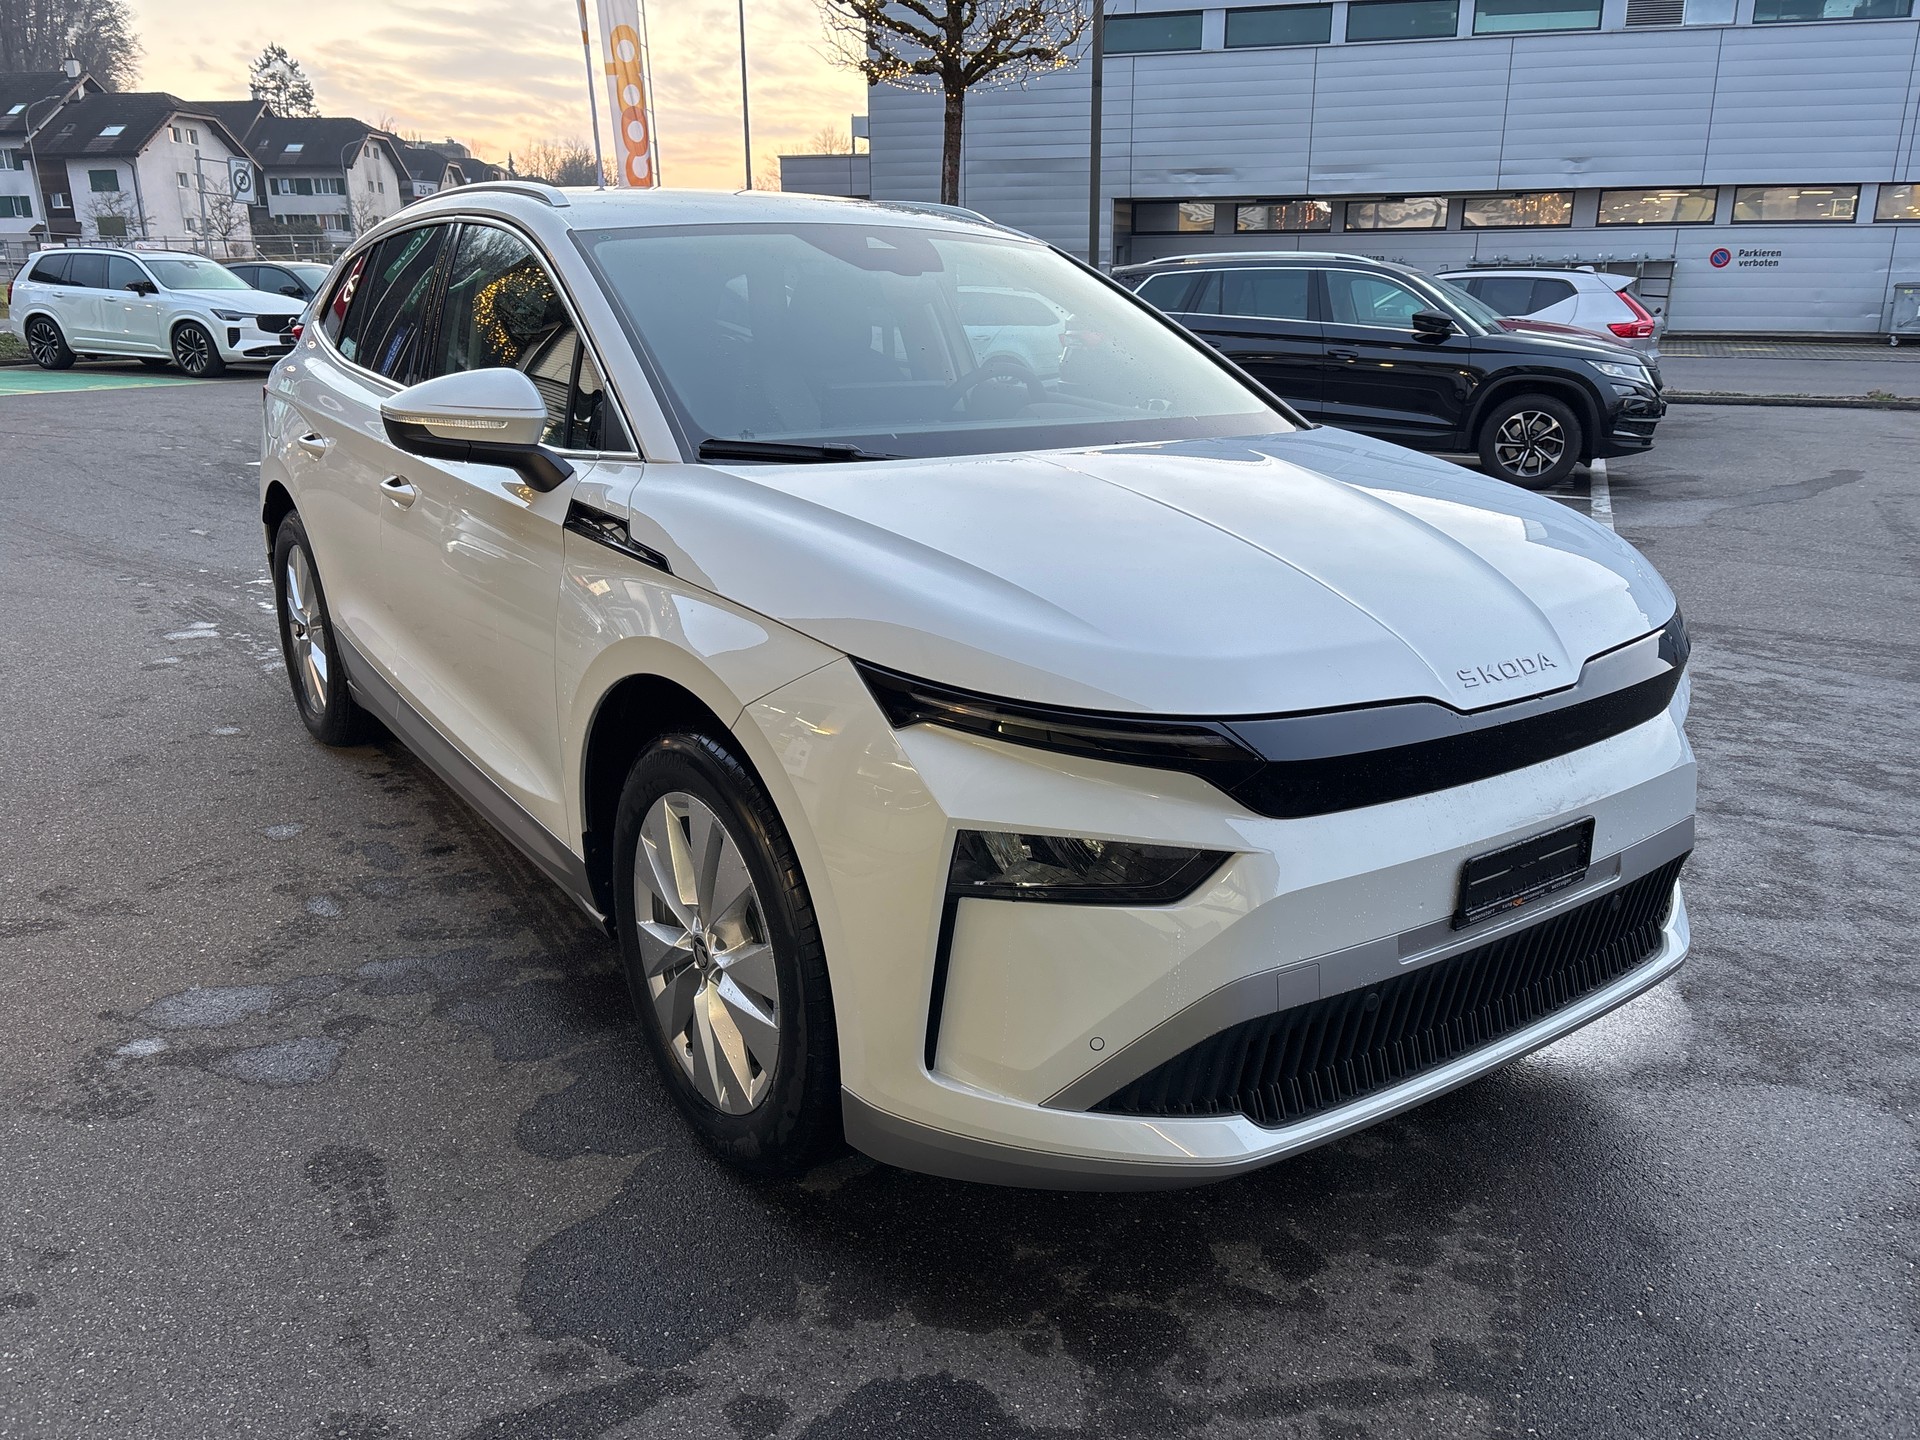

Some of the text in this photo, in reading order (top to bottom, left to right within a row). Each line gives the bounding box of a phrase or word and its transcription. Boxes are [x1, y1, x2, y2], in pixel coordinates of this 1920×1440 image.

[419, 184, 426, 194] 25
[1738, 249, 1782, 257] Parkieren
[1738, 259, 1779, 267] verboten
